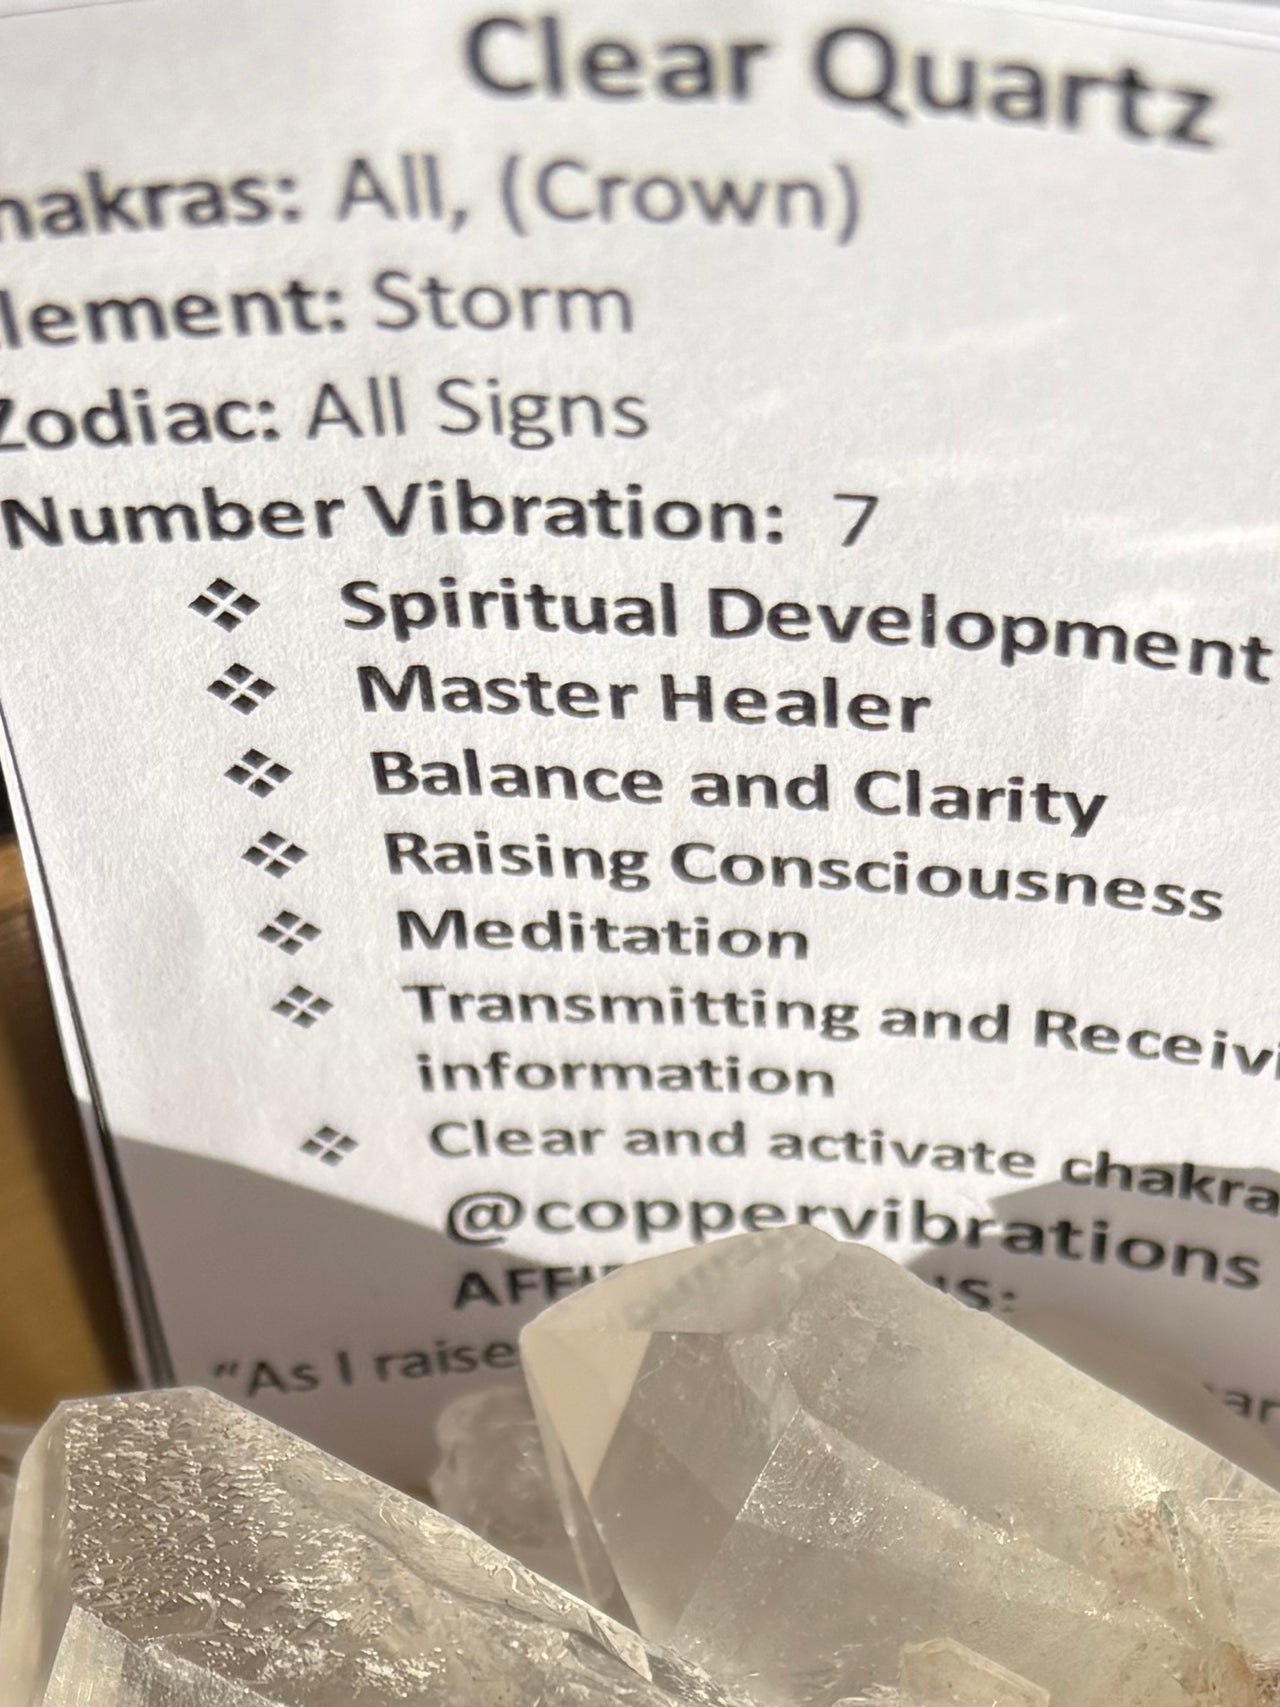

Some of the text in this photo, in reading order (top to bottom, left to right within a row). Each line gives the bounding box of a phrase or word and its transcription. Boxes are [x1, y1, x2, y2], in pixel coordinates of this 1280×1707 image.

[463, 13, 1216, 148] Clear Quartz
[338, 154, 467, 230] All,
[501, 155, 859, 244] (Crown)
[373, 269, 632, 332] Storm
[307, 375, 405, 439] All
[437, 378, 649, 450] Signs
[0, 478, 879, 550] Number Vibration: 7
[341, 576, 1273, 684] Spiritual Development
[357, 664, 931, 733] Master Healer
[370, 748, 1108, 837] Balance and Clarity
[384, 830, 1223, 925] Raising Consciousness
[397, 909, 808, 959] Meditation
[401, 983, 859, 1041] Transmitting
[880, 1003, 1010, 1043] and
[416, 1050, 834, 1096] information
[429, 1118, 605, 1157] Clear
[625, 1120, 745, 1156] and
[770, 1129, 1035, 1177] activate
[336, 1350, 352, 1385] I
[374, 1340, 518, 1381] raise
